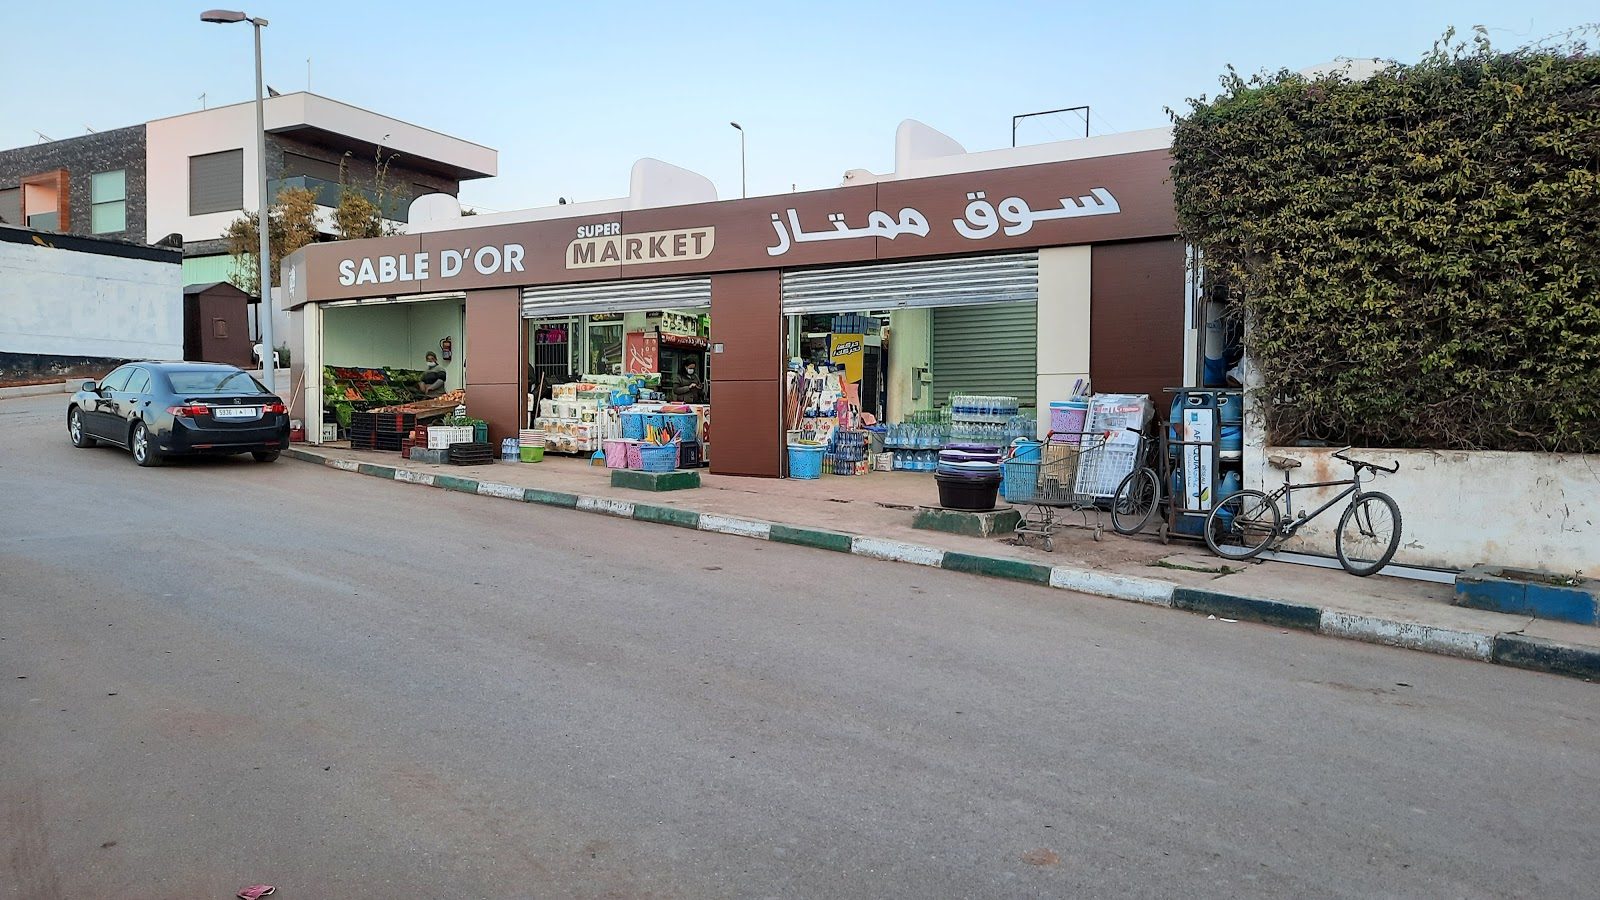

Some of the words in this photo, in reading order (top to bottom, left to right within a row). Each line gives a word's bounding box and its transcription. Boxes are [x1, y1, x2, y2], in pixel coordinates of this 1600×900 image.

[577, 222, 621, 239] SUPER
[766, 207, 931, 256] ممتاز
[952, 187, 1121, 240] سوق
[573, 231, 707, 265] MARKET
[338, 251, 429, 287] SABLE
